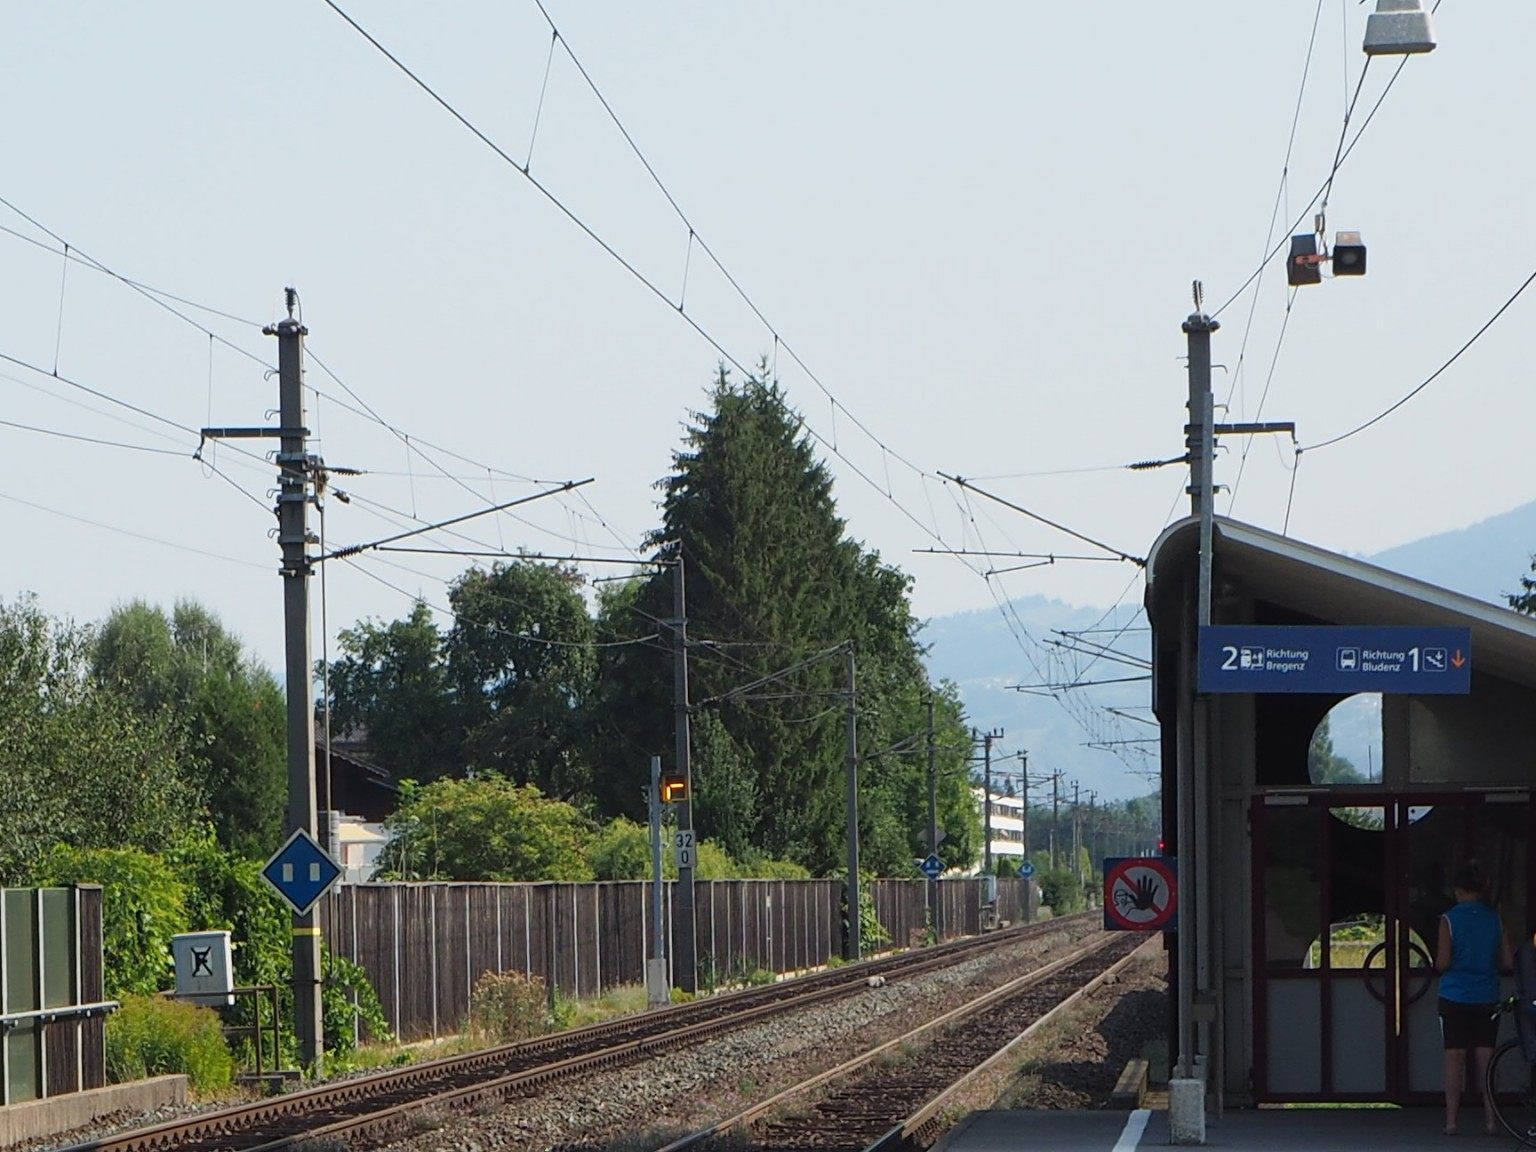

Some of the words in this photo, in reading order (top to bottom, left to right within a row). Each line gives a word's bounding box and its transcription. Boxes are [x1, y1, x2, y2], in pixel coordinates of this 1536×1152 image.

[1221, 646, 1238, 670] 2
[1266, 649, 1309, 661] Richtung
[1362, 650, 1405, 662] Richtung
[1408, 648, 1419, 672] 1
[1266, 661, 1305, 673] Bregenz
[1362, 662, 1401, 672] Bludenz
[676, 833, 692, 848] 32
[681, 850, 689, 864] 0
